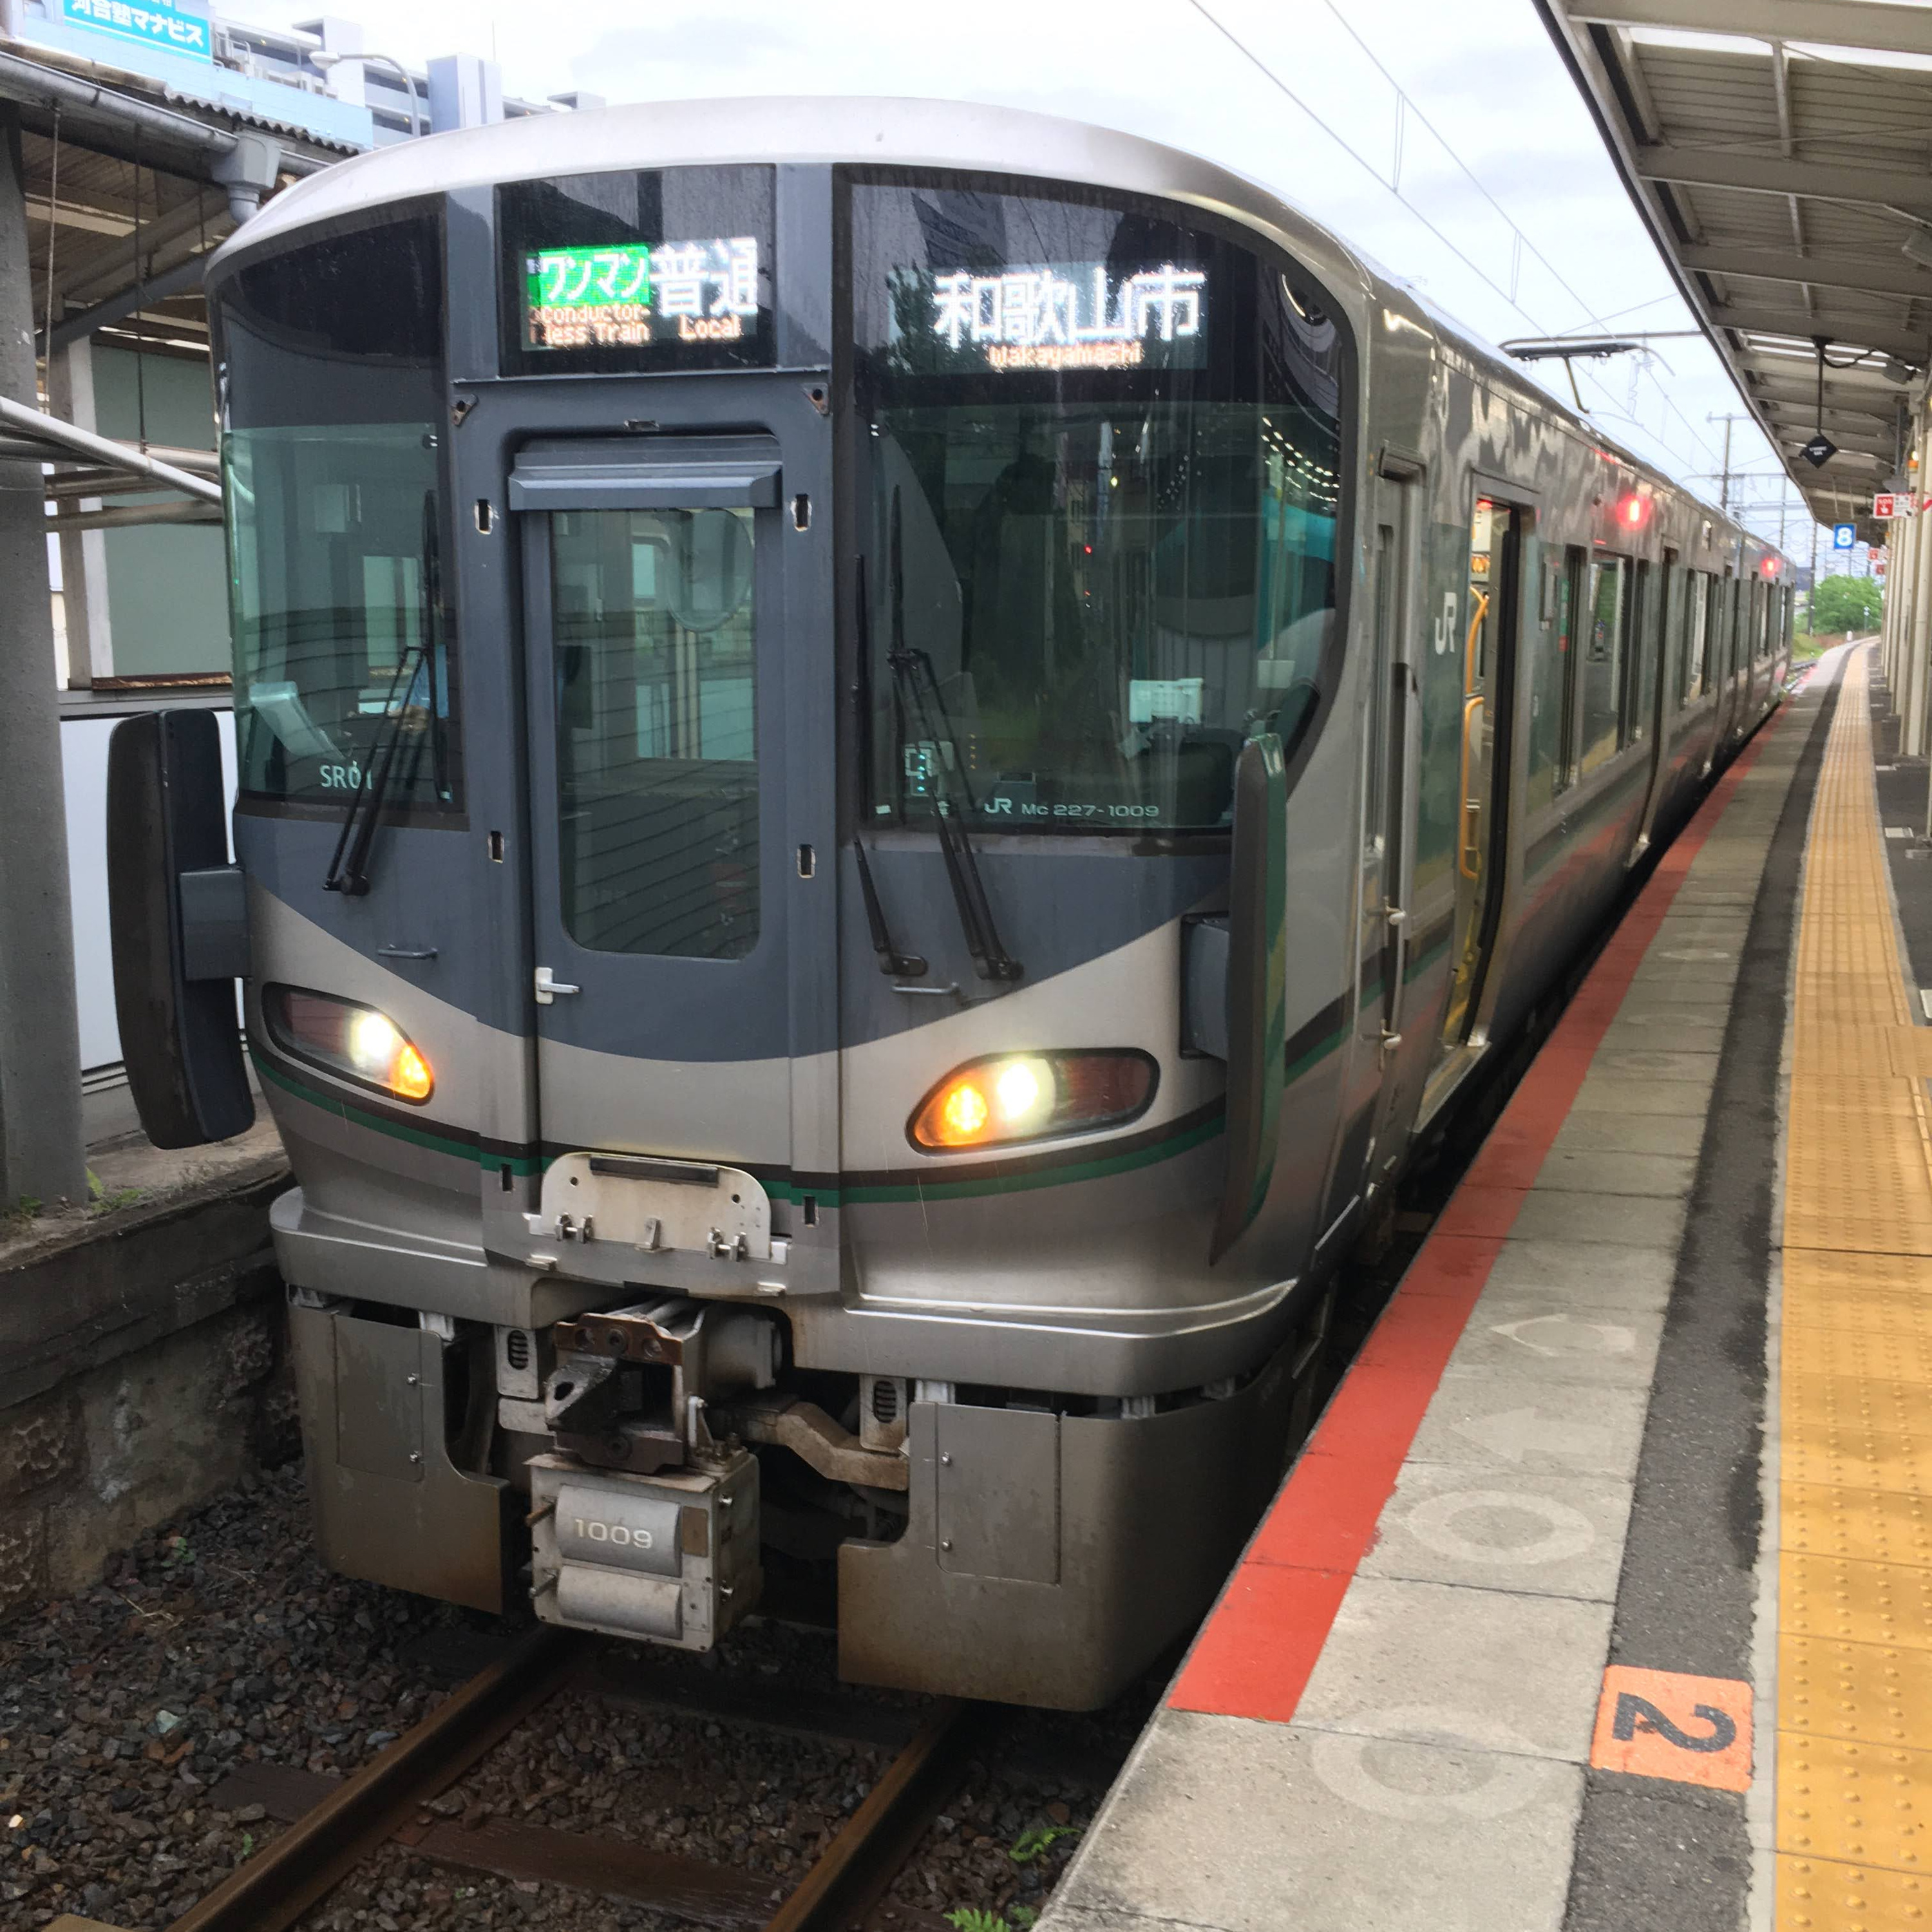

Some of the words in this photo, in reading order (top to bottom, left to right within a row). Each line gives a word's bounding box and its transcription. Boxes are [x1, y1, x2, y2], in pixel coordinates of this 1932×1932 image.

[541, 252, 647, 301] ワンマン
[649, 236, 759, 318] 普通
[933, 265, 1205, 348] 和歌山市
[593, 321, 649, 344] Train
[678, 313, 742, 342] Local
[1837, 526, 1853, 546] 8
[1435, 592, 1457, 655] JR
[984, 797, 1012, 815] JR
[1021, 803, 1049, 816] Mc
[1053, 804, 1160, 817] 227-1009
[575, 1519, 653, 1549] 1009
[1612, 1691, 1737, 1752] 2
